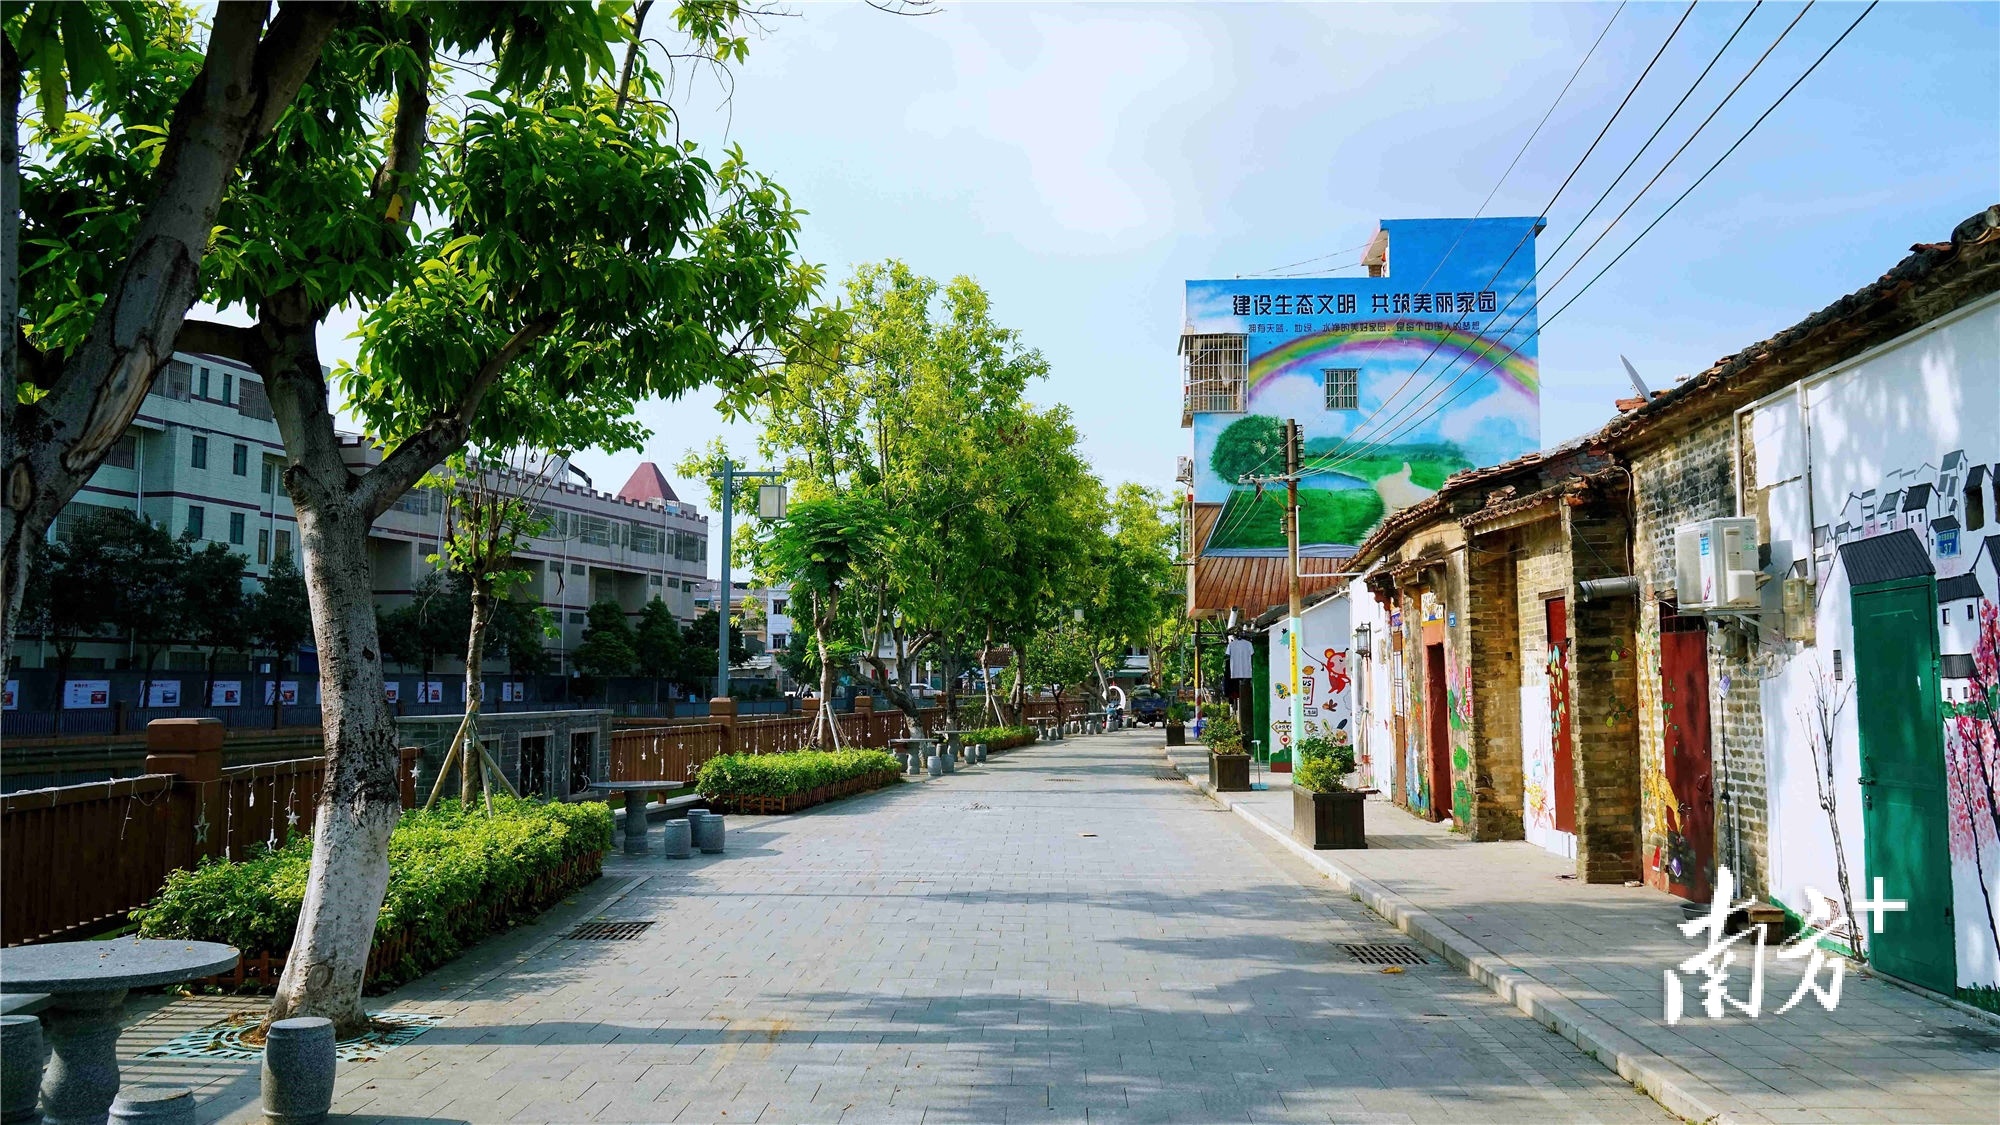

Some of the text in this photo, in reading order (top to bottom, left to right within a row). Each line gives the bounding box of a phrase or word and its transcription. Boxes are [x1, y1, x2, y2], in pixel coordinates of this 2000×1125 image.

[1233, 291, 1498, 316] 建设生态文明 共筑美丽家园
